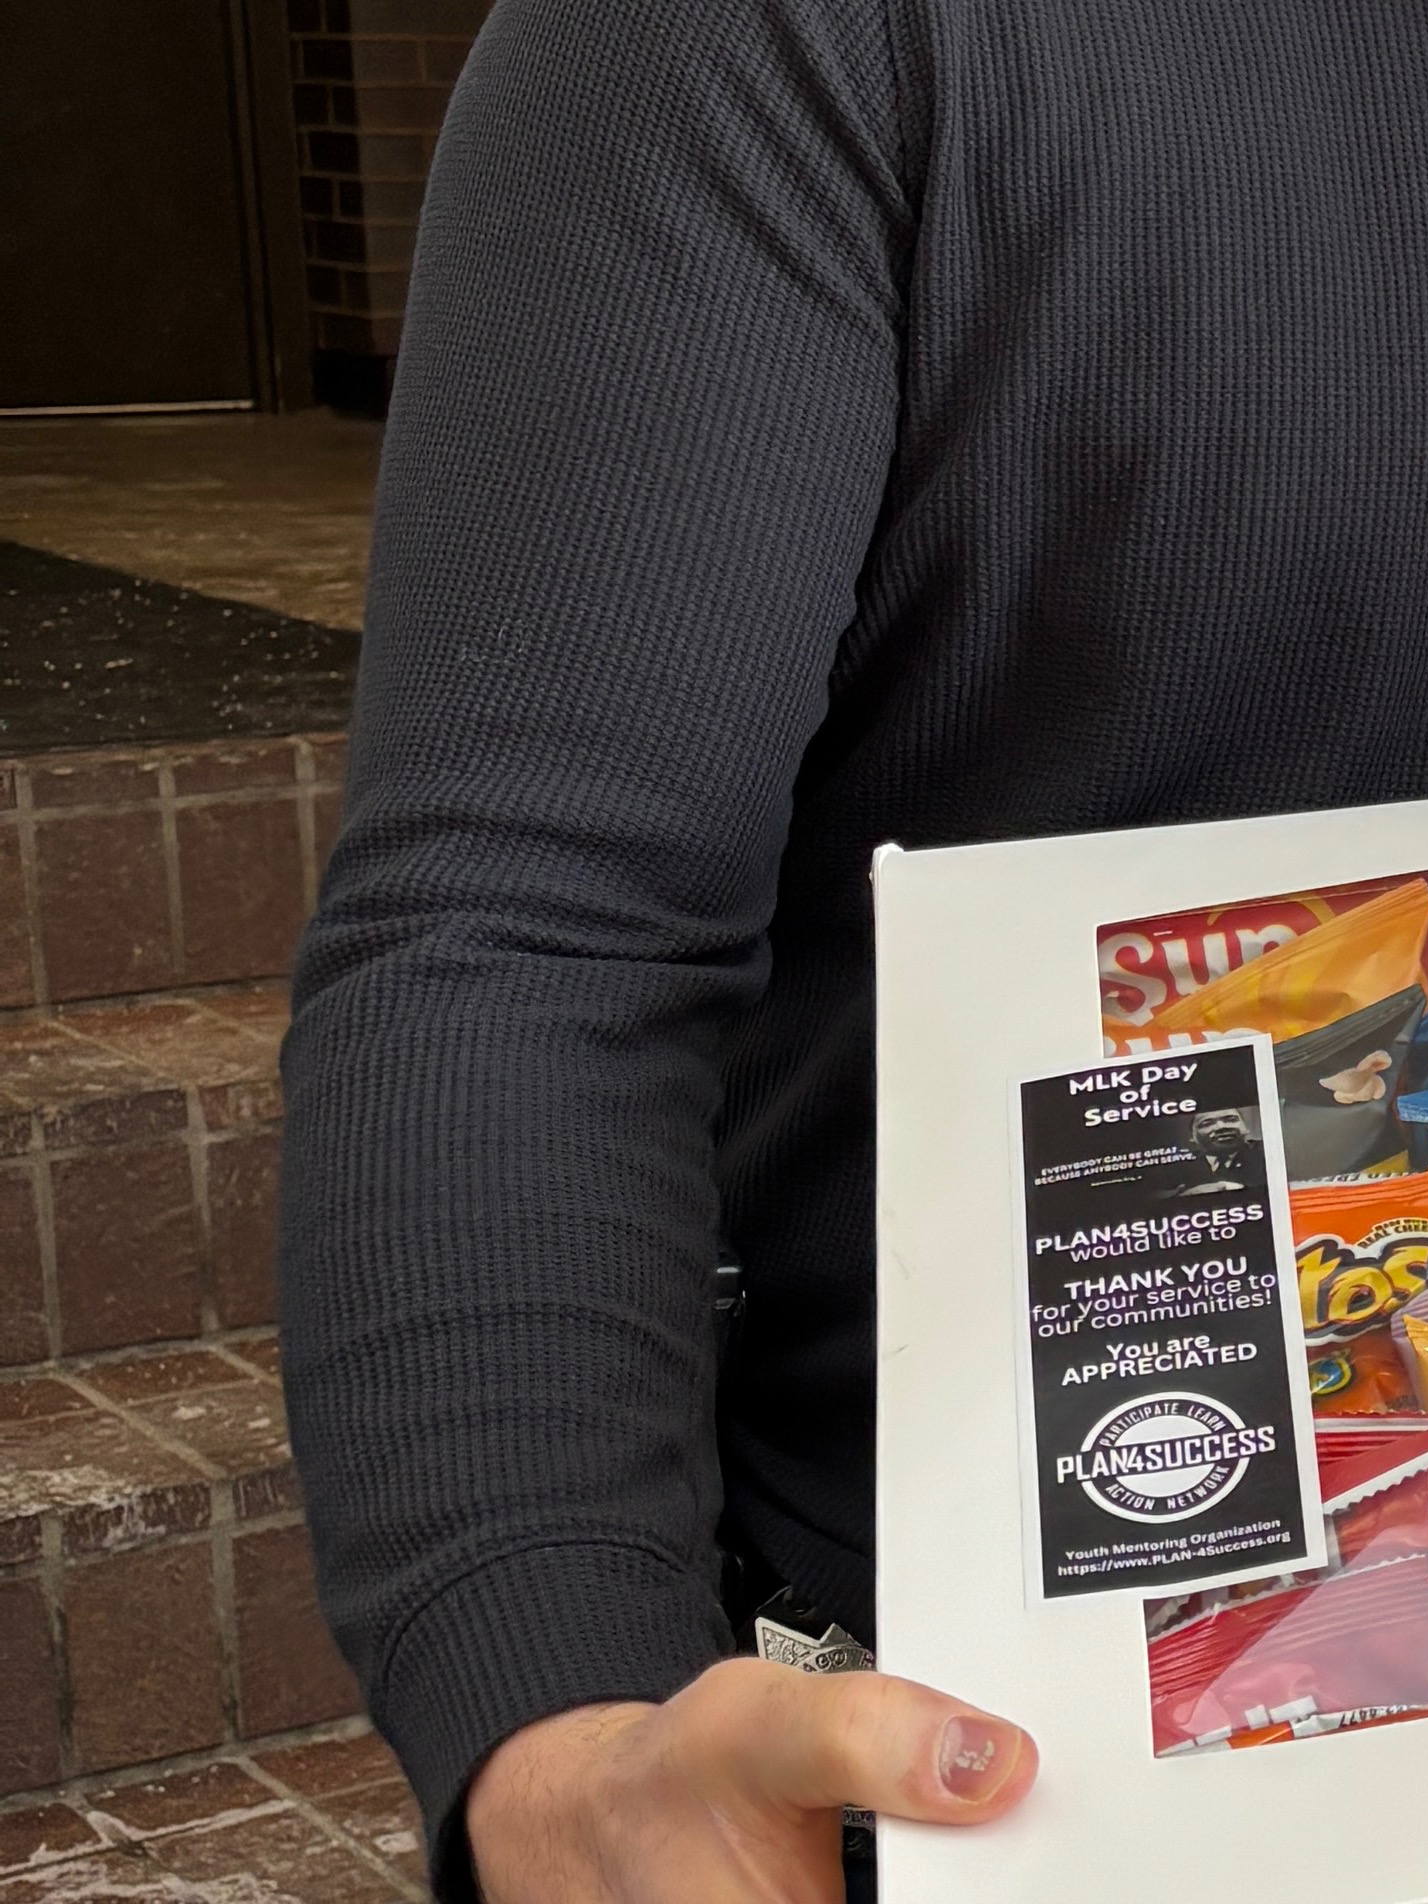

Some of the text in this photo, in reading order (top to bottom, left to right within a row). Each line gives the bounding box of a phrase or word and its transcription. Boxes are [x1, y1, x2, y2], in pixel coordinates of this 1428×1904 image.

[1069, 1062, 1198, 1095] MLK Day
[1119, 1084, 1151, 1104] of
[1083, 1098, 1198, 1127] Service
[1103, 1153, 1128, 1164] CAN
[1035, 1204, 1265, 1255] PLAN4SUCCESS
[1069, 1225, 1237, 1263] would like to
[1031, 1273, 1277, 1323] for your service to
[1064, 1256, 1248, 1300] THANK YOU
[1037, 1288, 1273, 1339] our communities!
[1060, 1342, 1258, 1386] APPRECIATED
[1106, 1333, 1212, 1362] You are
[1099, 1402, 1227, 1447] PARTICIPATE LEARN
[1056, 1424, 1277, 1484] PLAN4SUCCESS
[1105, 1464, 1230, 1511] ACTION NETWORK
[1065, 1518, 1283, 1562] Youth Mentoring Organization
